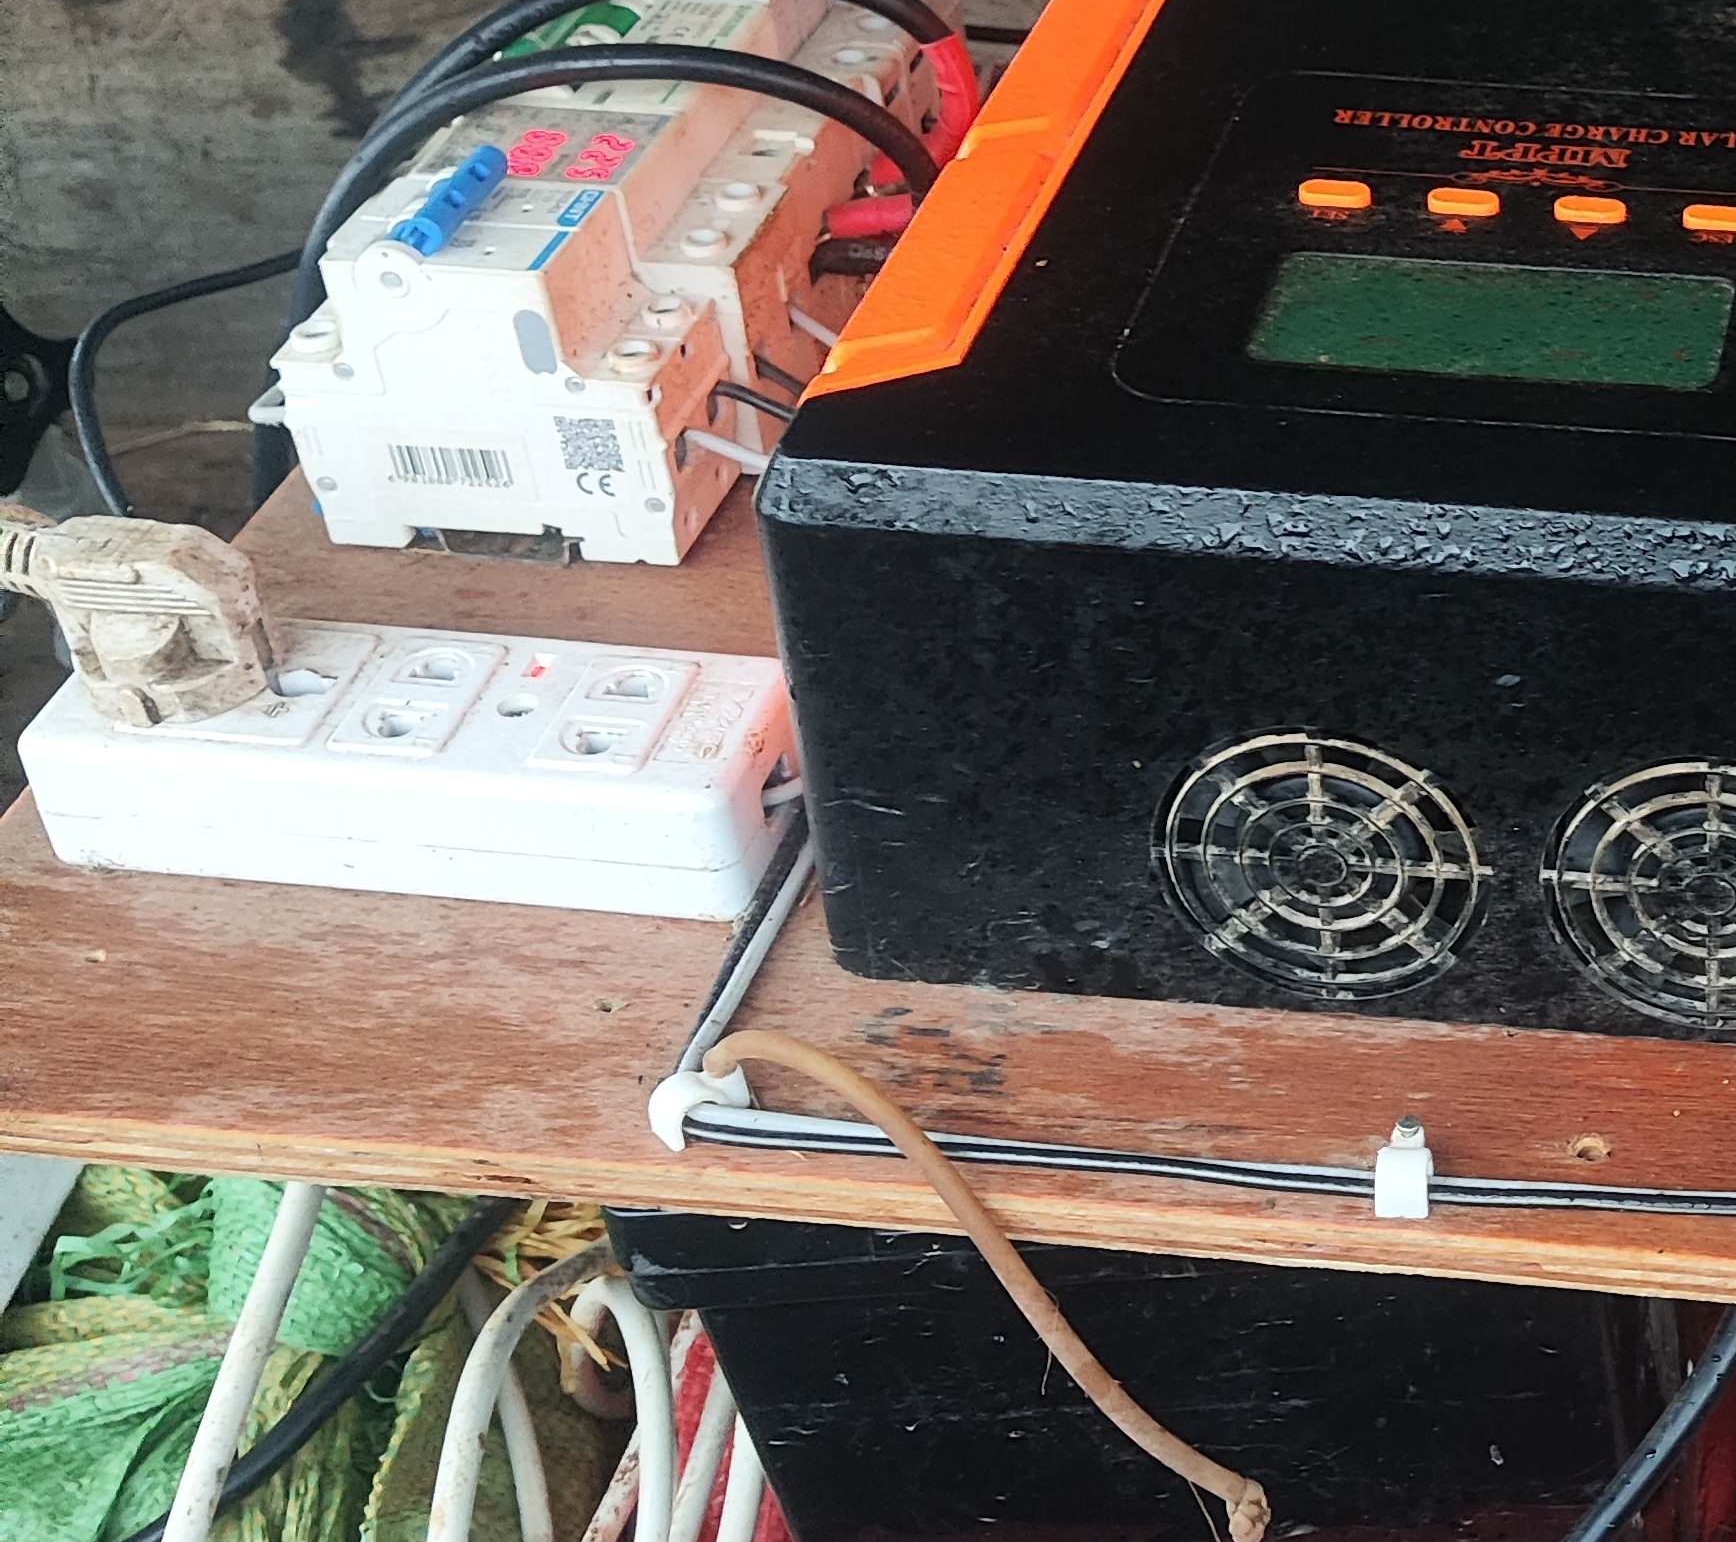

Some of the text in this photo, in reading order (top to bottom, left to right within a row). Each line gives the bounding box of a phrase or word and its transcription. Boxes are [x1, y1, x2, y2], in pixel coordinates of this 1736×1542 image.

[1336, 110, 1536, 135] CONTROLLER
[1549, 124, 1668, 143] CHARGE
[1460, 140, 1633, 168] MPPT
